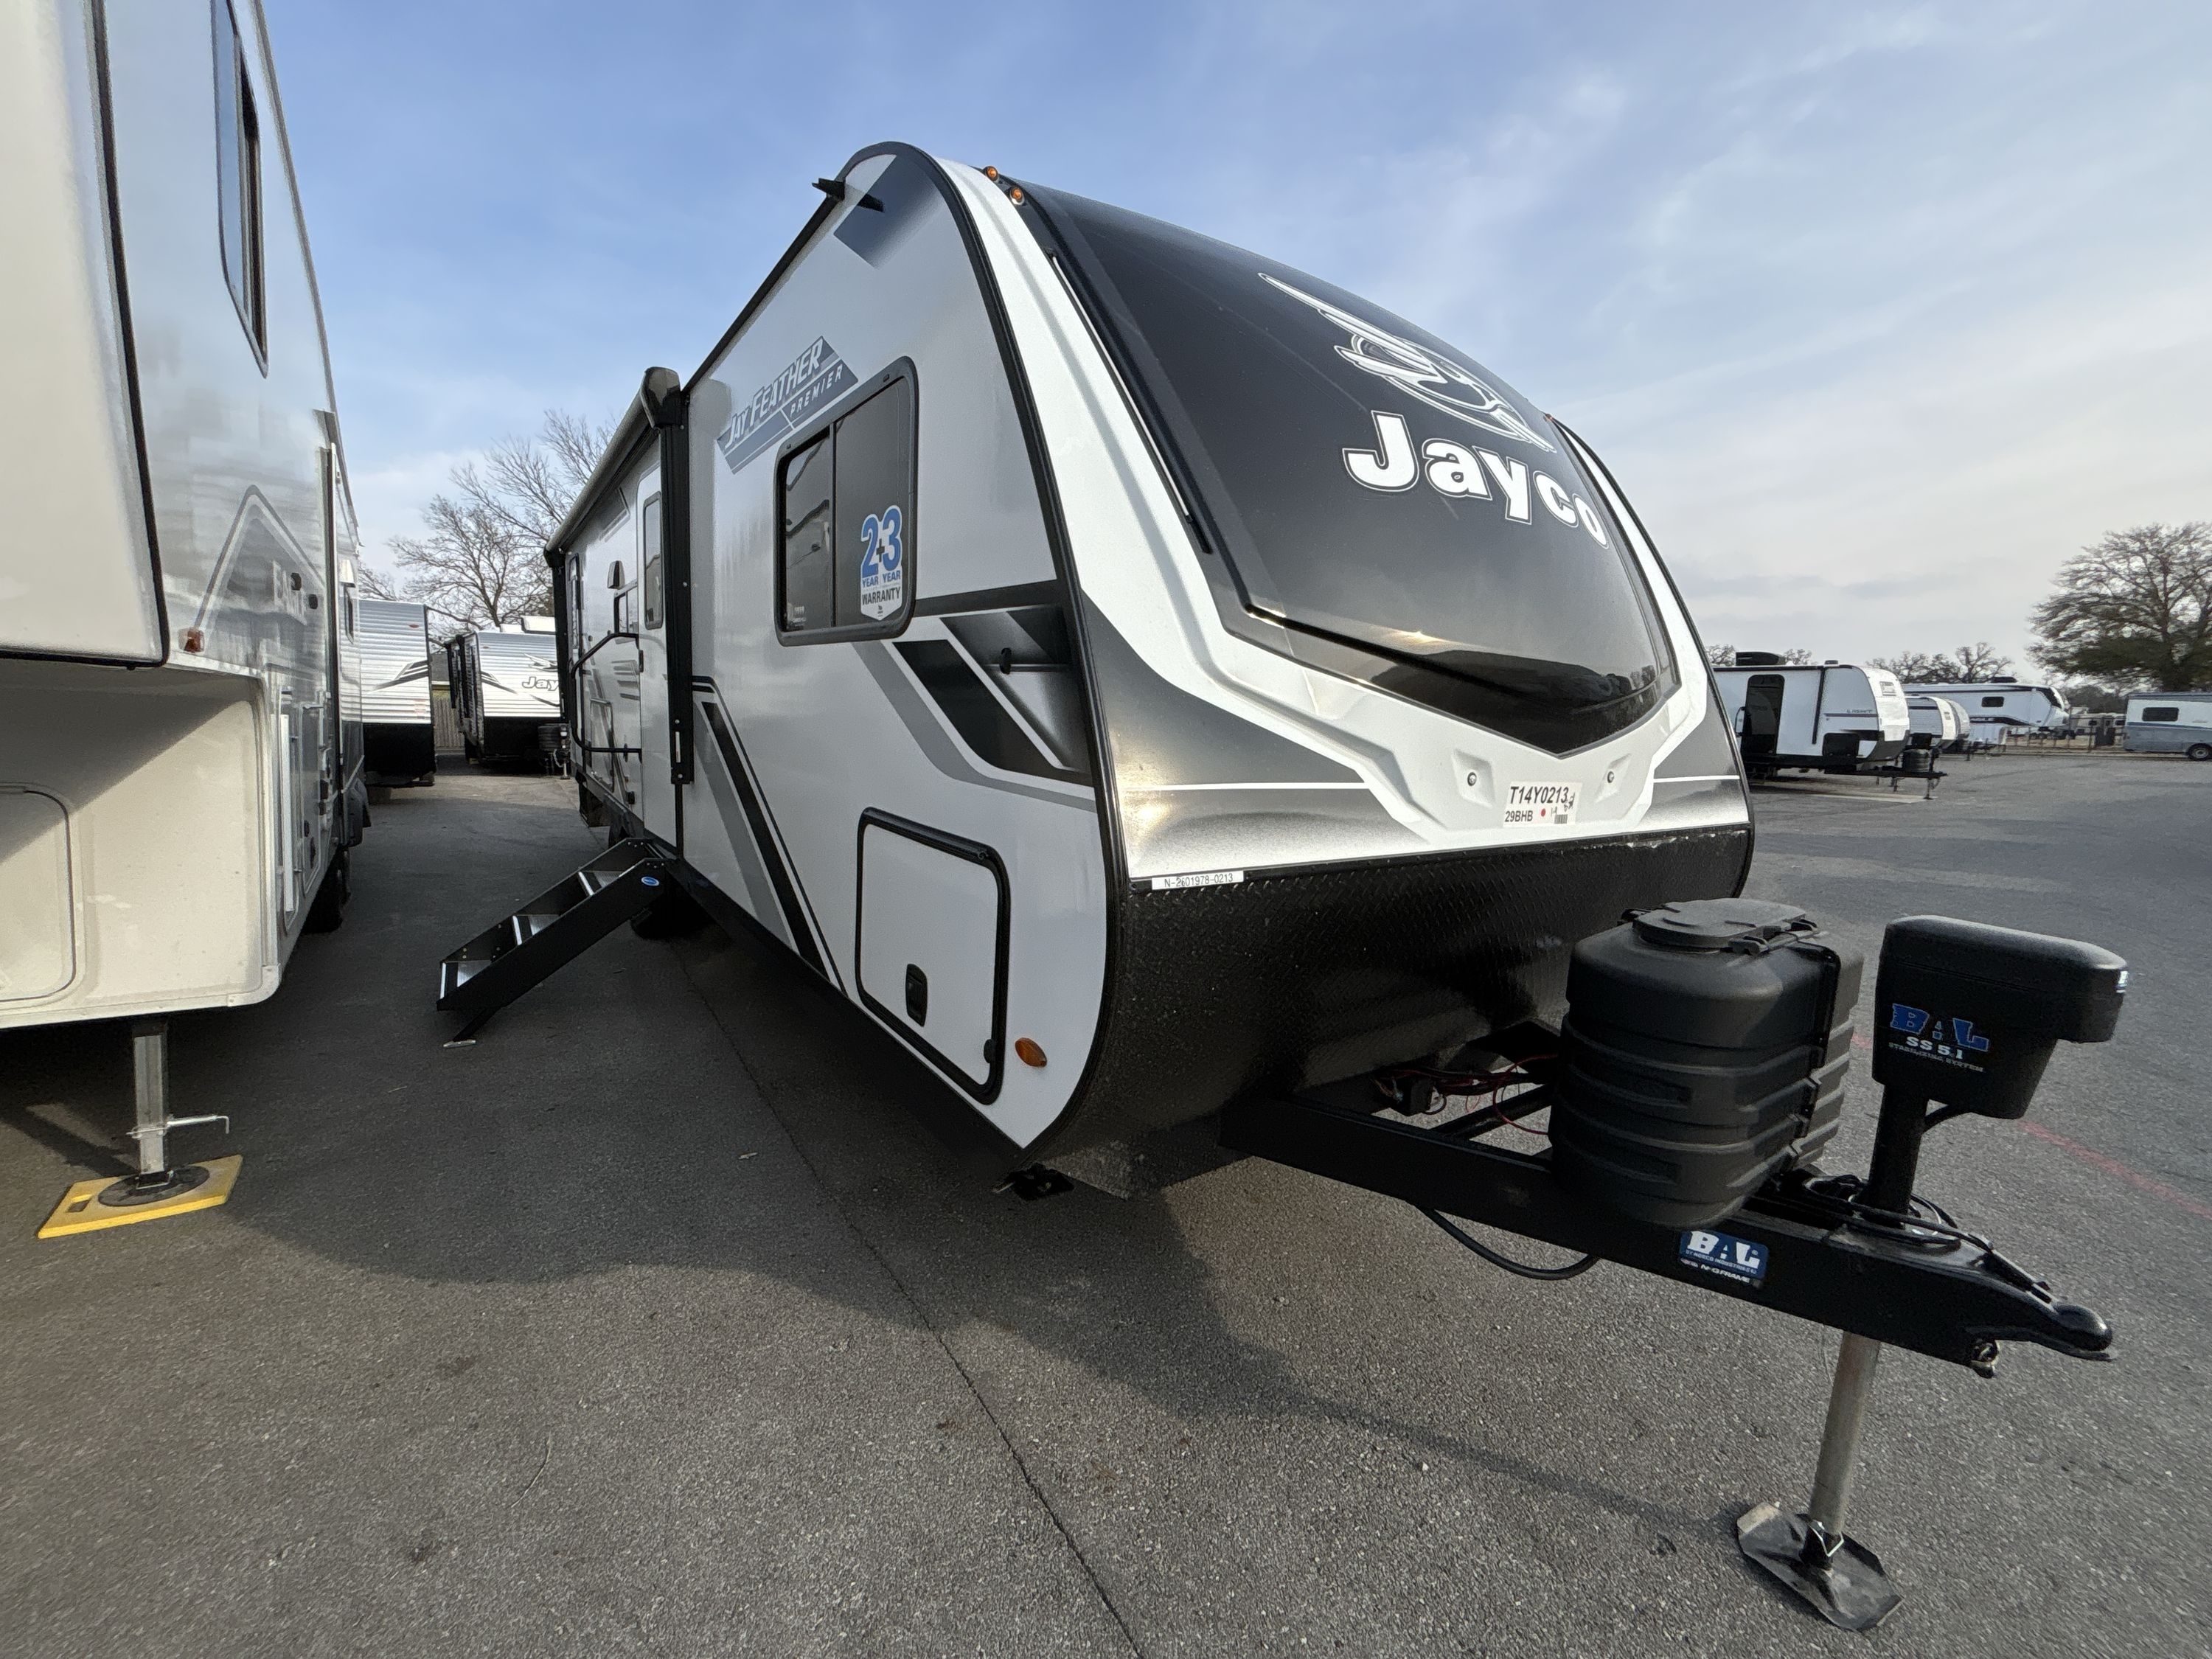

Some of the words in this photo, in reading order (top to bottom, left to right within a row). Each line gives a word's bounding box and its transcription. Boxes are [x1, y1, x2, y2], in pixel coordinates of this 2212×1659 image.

[725, 408, 750, 449] JAY
[750, 338, 824, 426] FEATHER
[790, 364, 843, 417] PREMIER
[1342, 410, 1609, 549] Jayco
[862, 576, 879, 588] YEAR
[883, 570, 901, 582] YEAR
[862, 587, 900, 605] WARRANTY
[1510, 786, 1569, 804] T14Y0213
[1504, 810, 1534, 822] 29BHB
[1890, 1004, 1989, 1052] BAL
[1905, 1036, 1933, 1051] SS
[1719, 1270, 1750, 1284] FRAME
